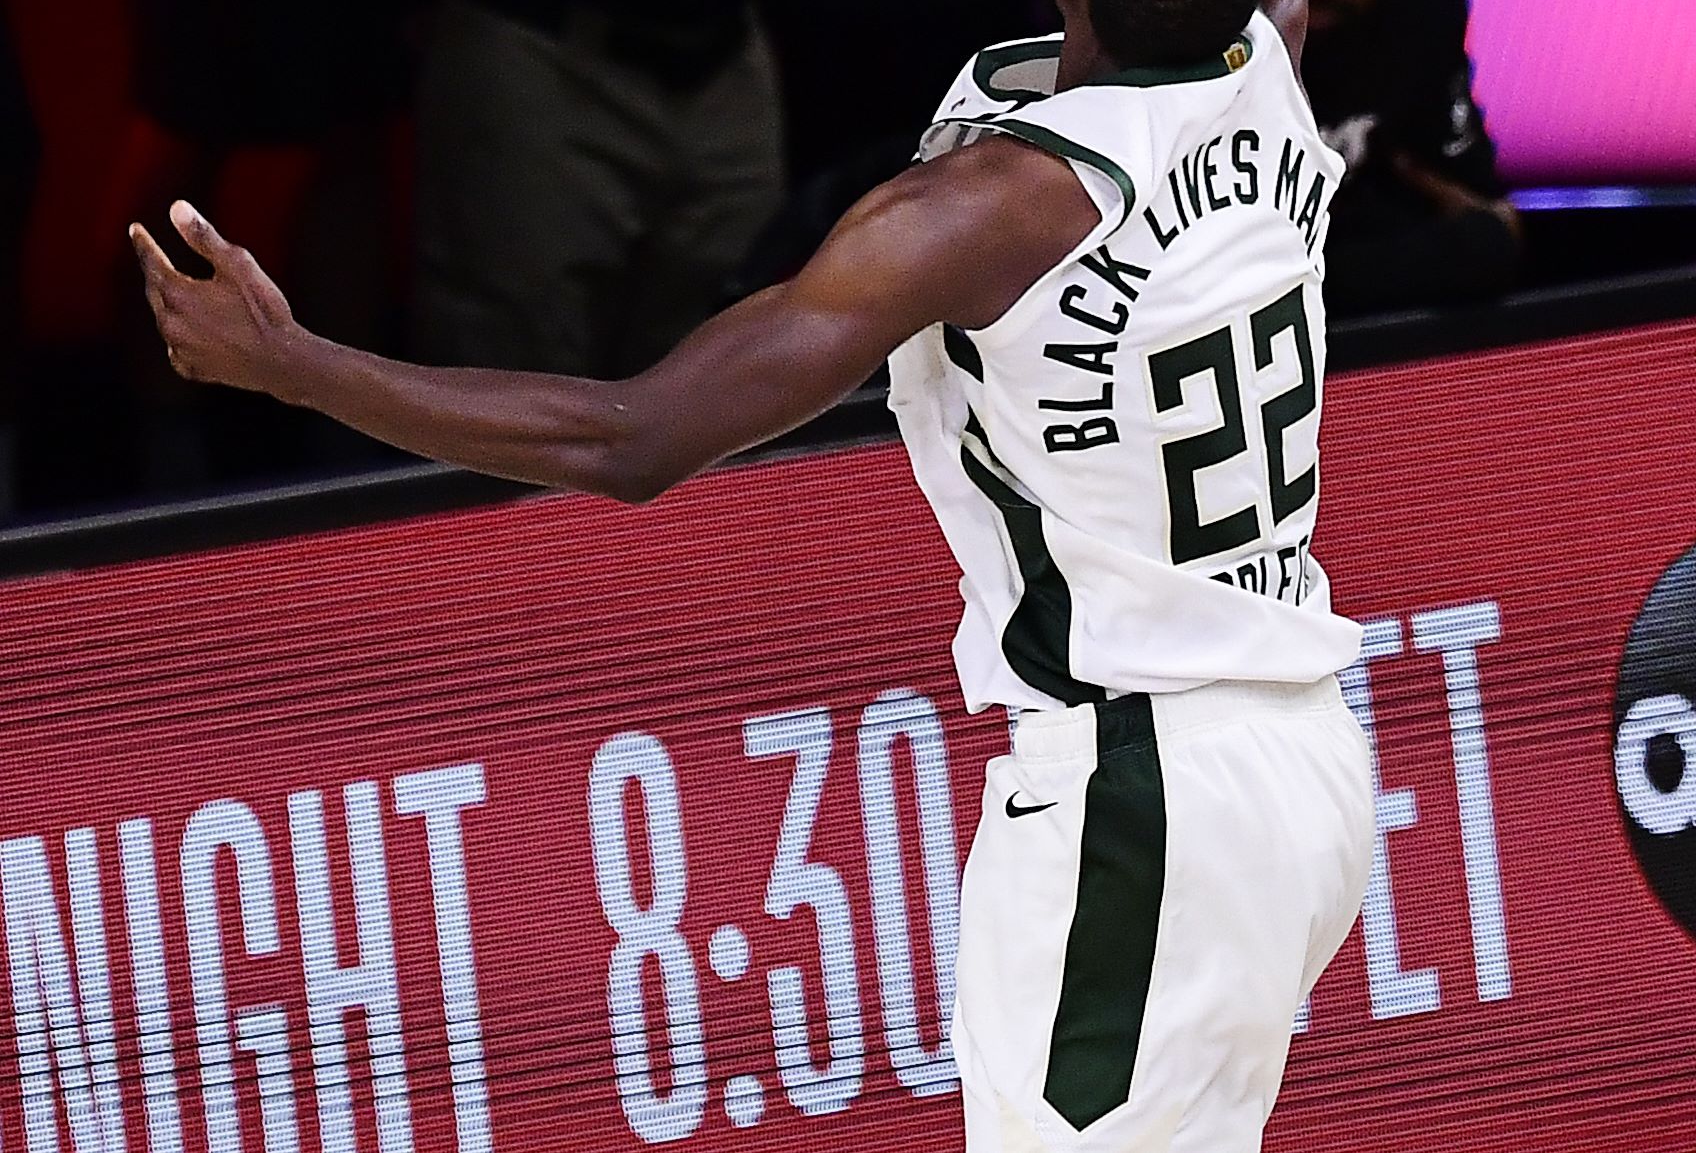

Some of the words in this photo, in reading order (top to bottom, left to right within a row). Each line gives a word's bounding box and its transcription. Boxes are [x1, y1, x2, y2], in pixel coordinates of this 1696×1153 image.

[1038, 244, 1152, 454] BLACK
[1143, 130, 1260, 251] LIVES
[1146, 281, 1318, 566] 22
[587, 688, 962, 1144] 8:30
[1334, 601, 1512, 1019] ET
